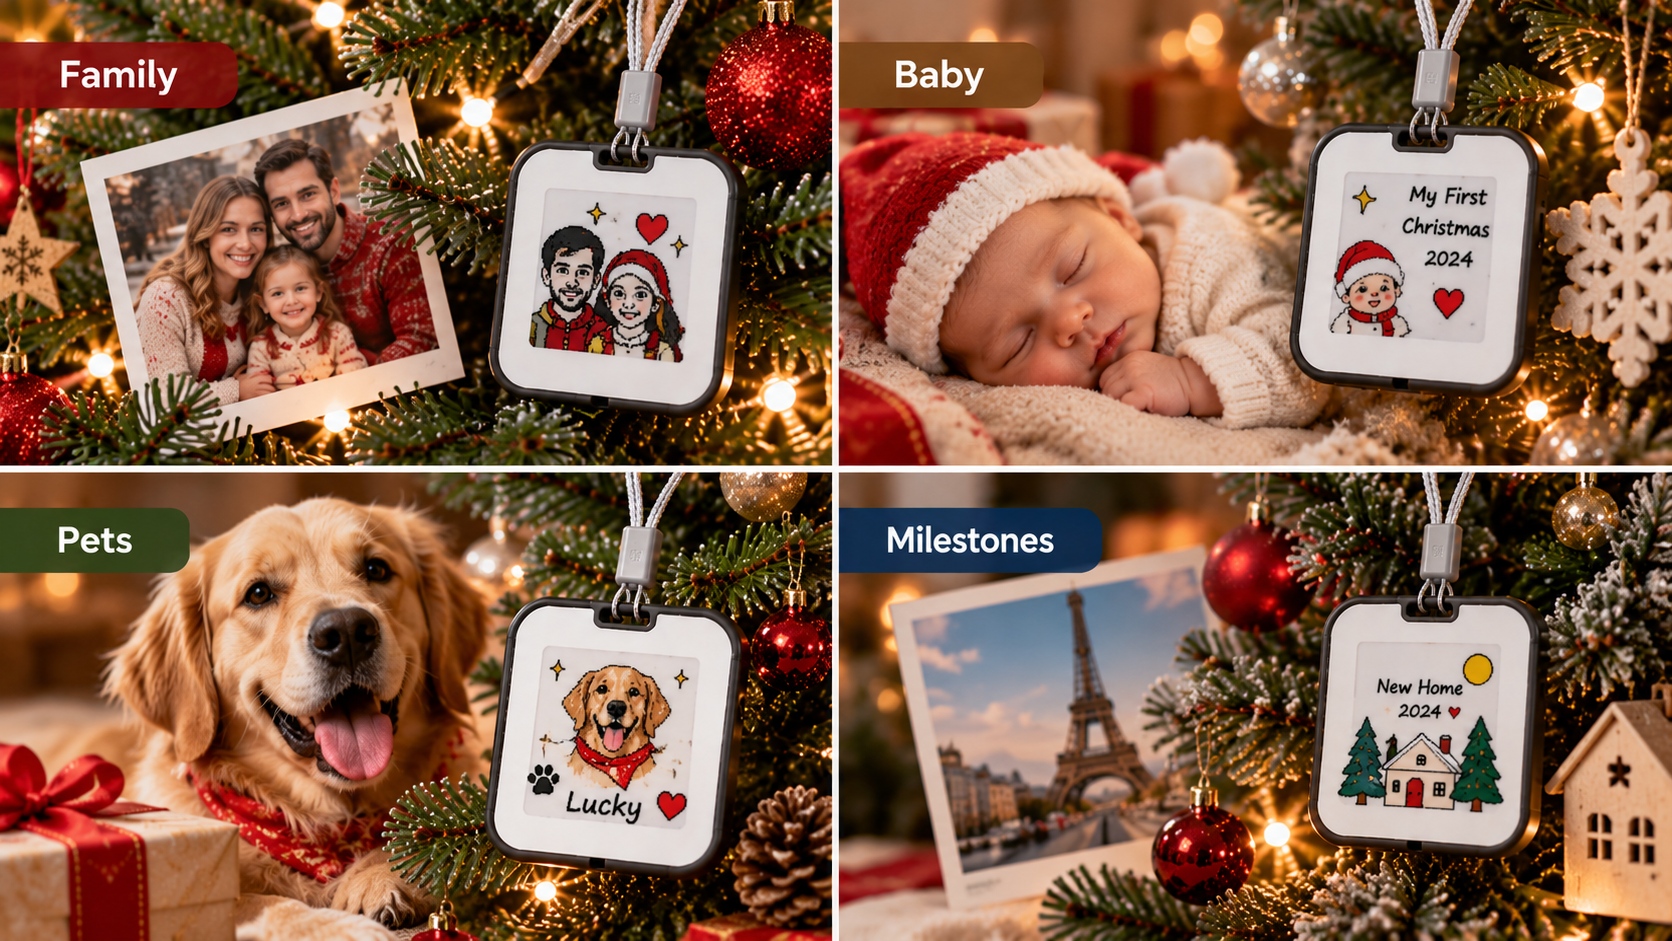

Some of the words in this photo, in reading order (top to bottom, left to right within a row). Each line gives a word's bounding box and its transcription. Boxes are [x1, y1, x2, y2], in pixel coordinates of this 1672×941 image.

[1409, 185, 1437, 208] My
[1445, 187, 1488, 206] First
[1402, 216, 1490, 238] Christmas
[1424, 250, 1474, 268] 2024
[1377, 678, 1412, 694] New
[1417, 678, 1463, 695] Home
[1398, 703, 1442, 719] 2024
[566, 790, 642, 825] Lucky
